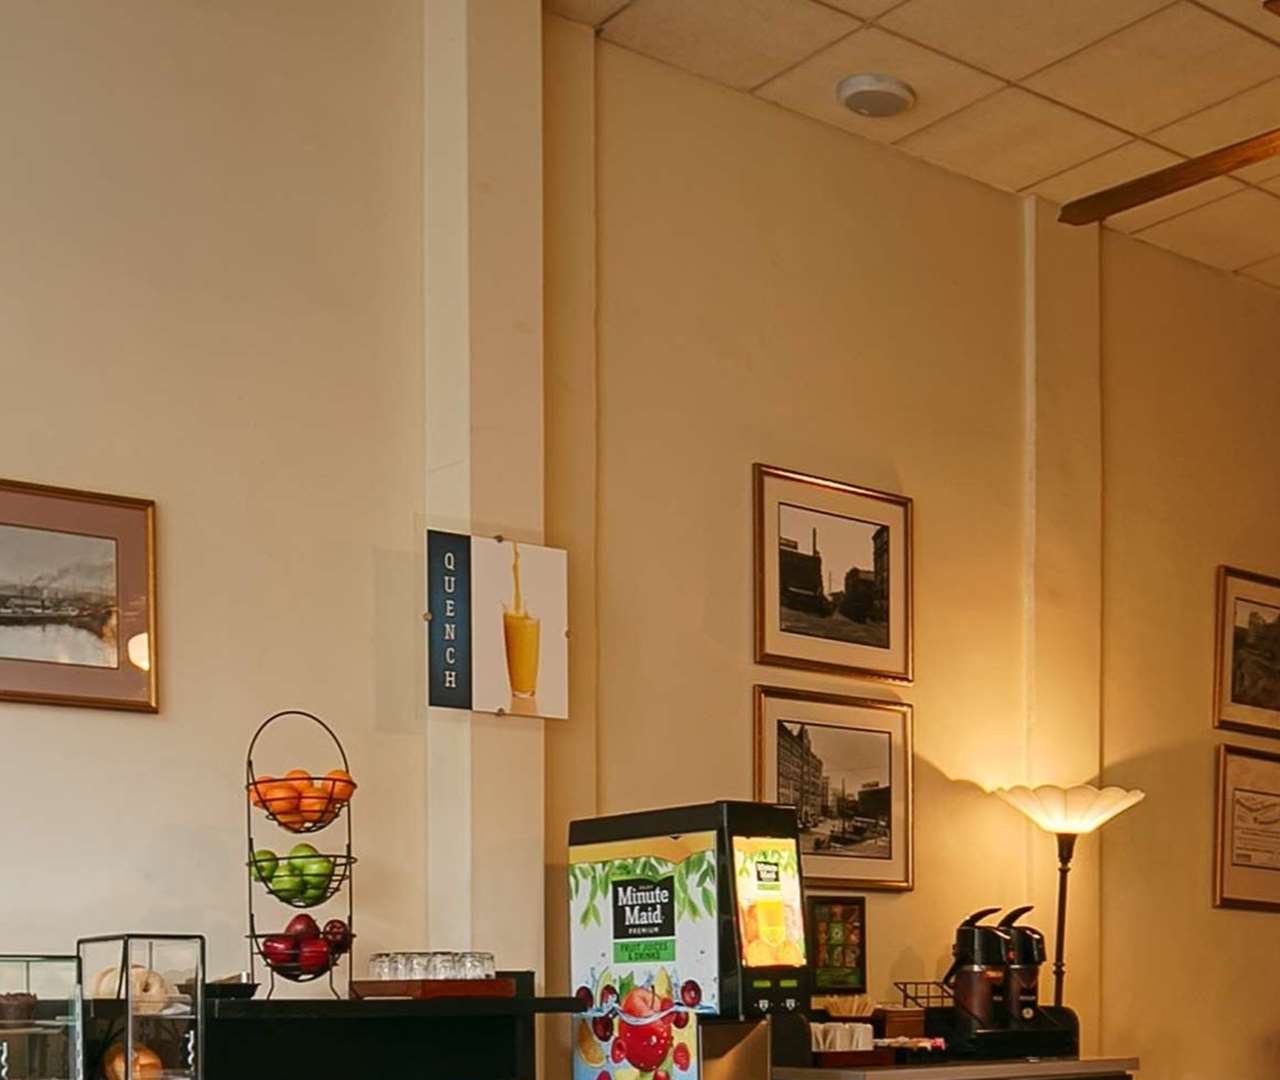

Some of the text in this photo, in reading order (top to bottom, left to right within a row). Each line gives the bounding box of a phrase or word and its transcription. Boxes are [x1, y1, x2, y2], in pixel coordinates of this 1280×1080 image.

[444, 552, 457, 688] QUENCH
[617, 886, 669, 906] Minute
[624, 904, 662, 925] Maid
